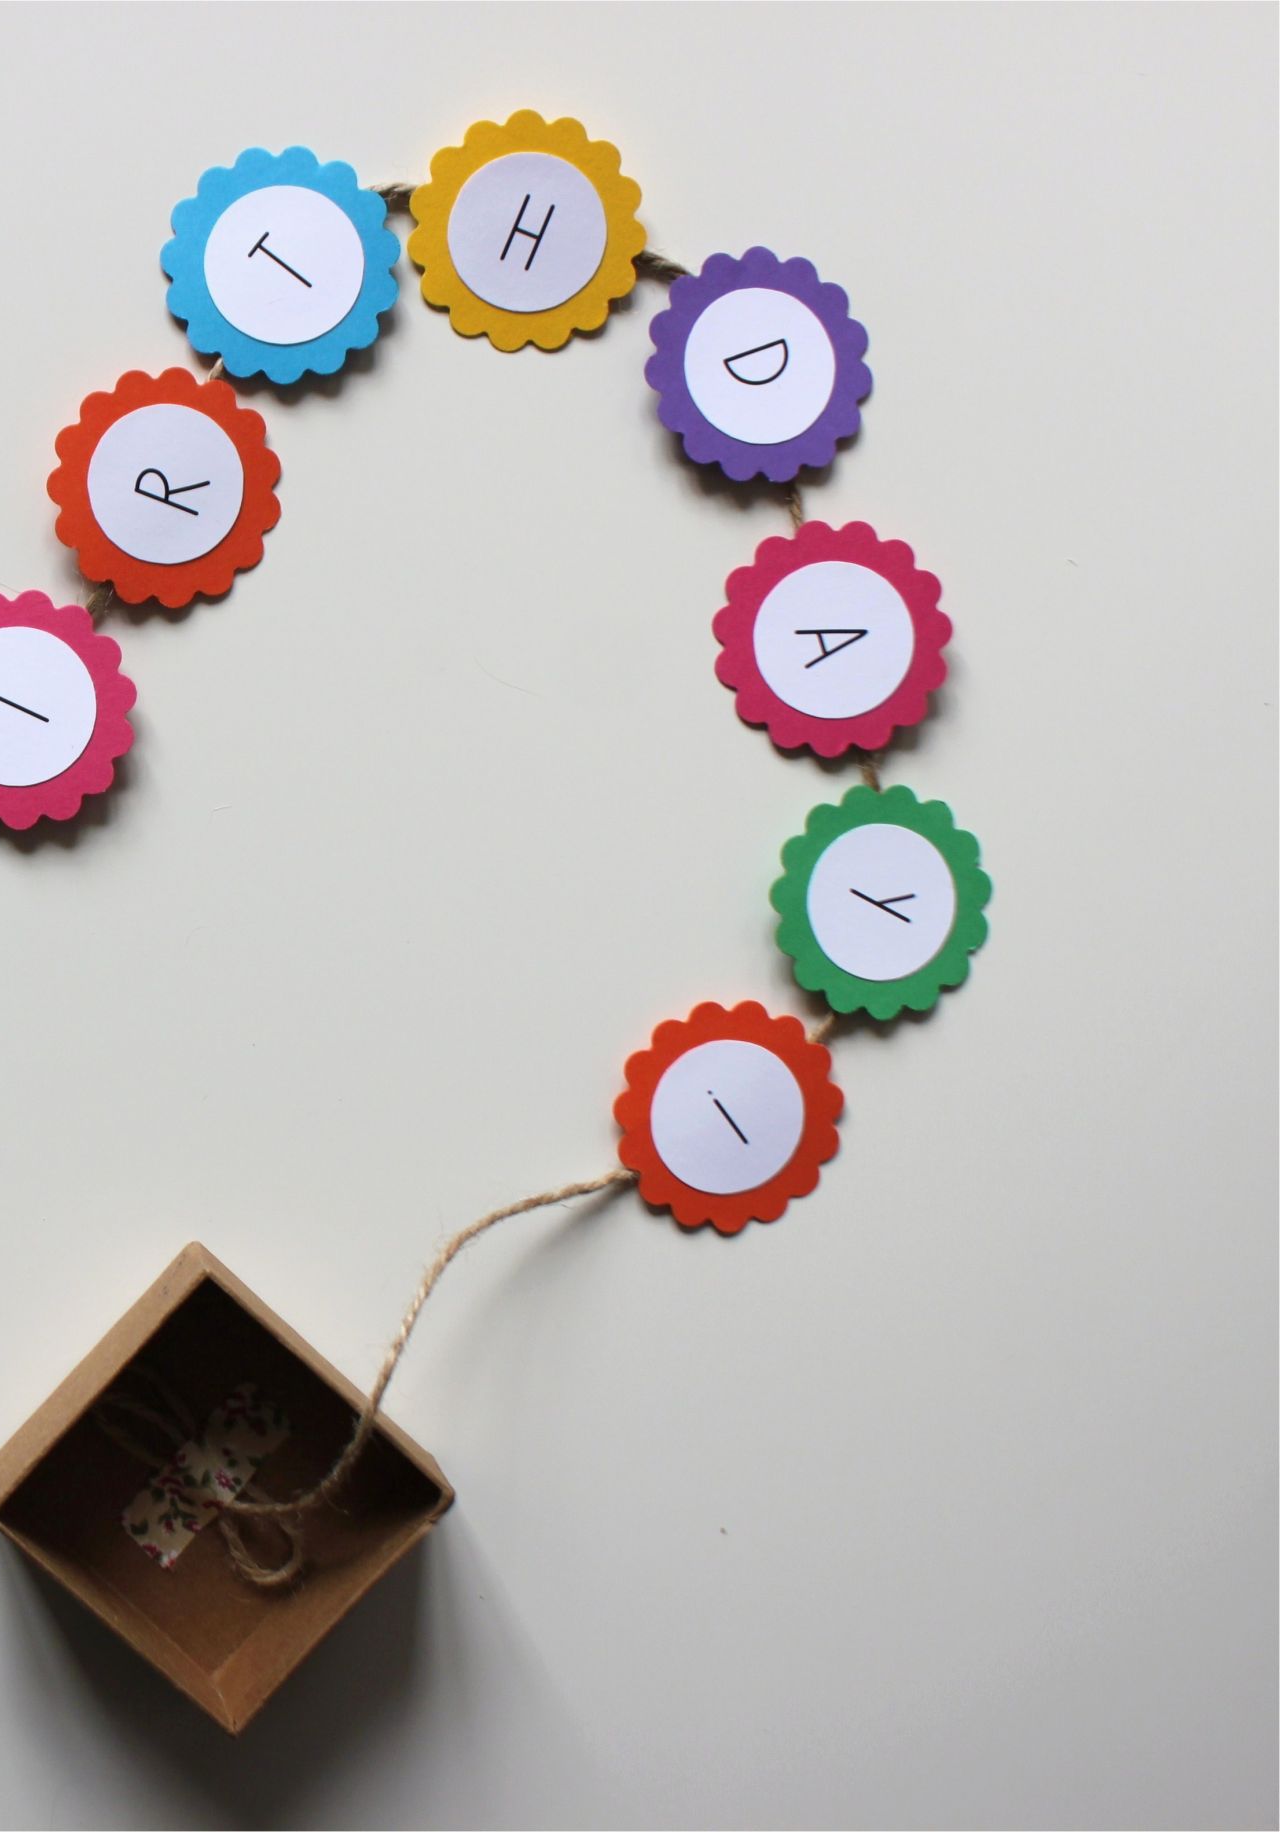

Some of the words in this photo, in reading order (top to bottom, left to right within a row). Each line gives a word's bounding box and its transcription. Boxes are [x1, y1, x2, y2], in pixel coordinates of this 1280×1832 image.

[134, 467, 211, 517] R
[247, 231, 313, 289] T
[499, 193, 556, 272] H
[723, 338, 789, 386] D
[794, 628, 869, 669] A
[850, 888, 916, 924] Y
